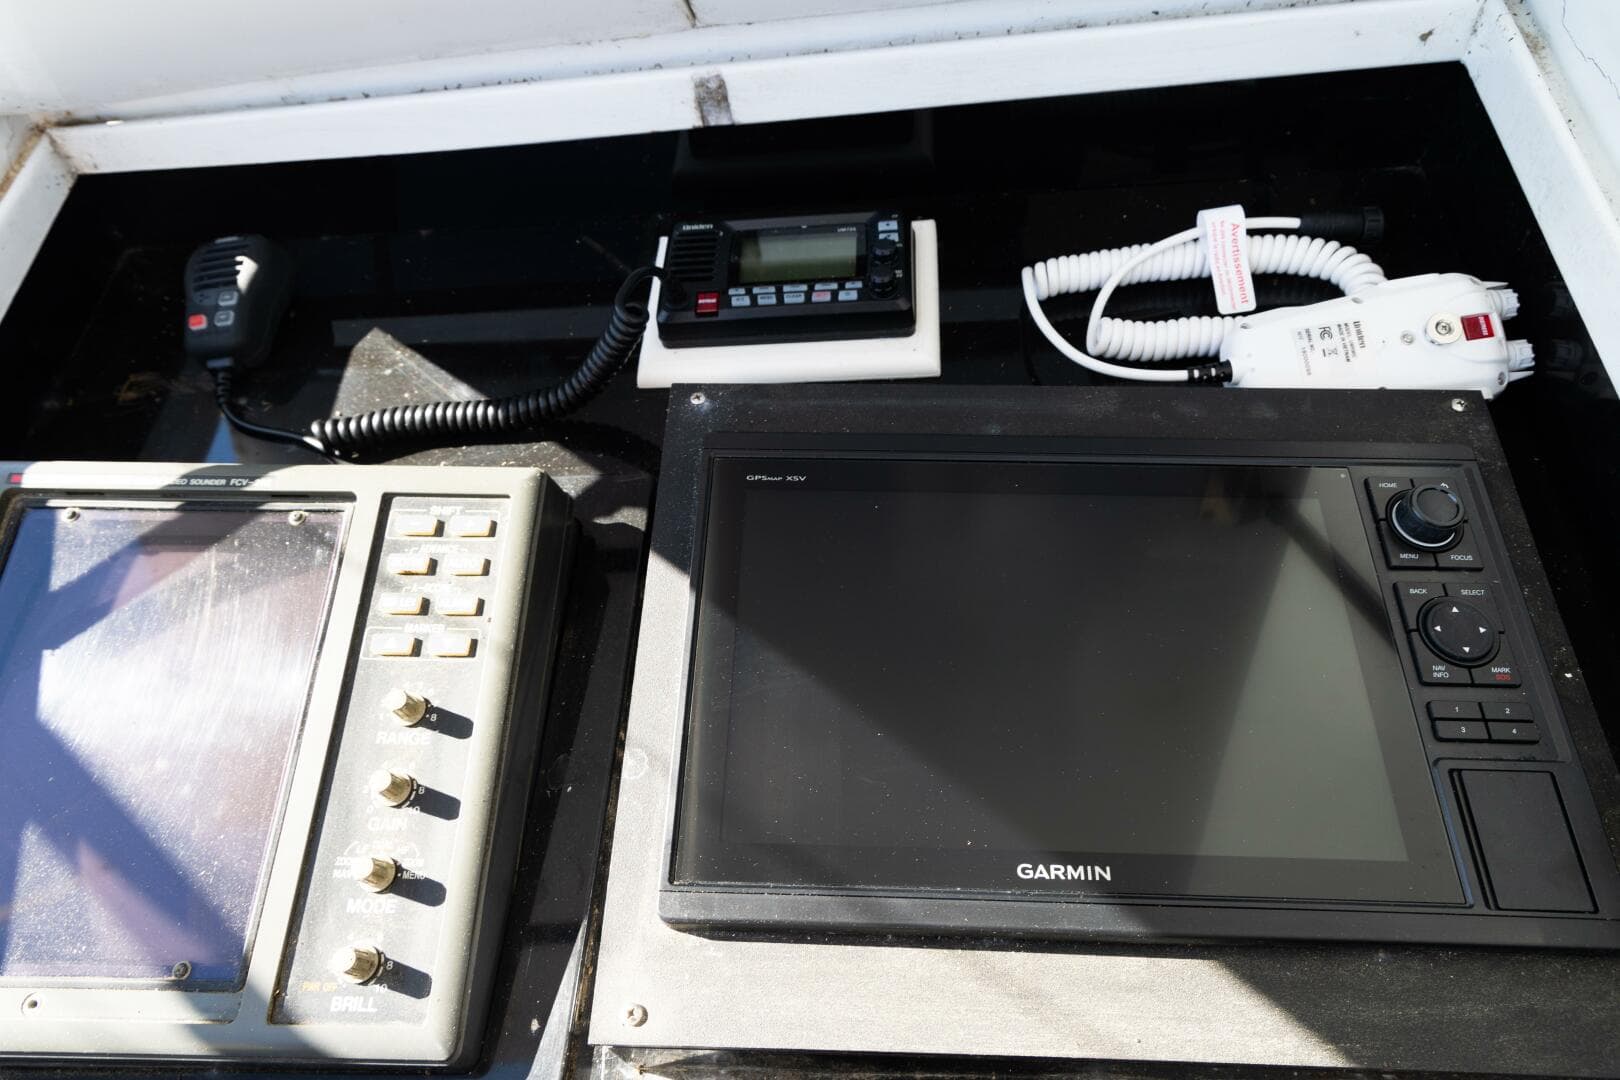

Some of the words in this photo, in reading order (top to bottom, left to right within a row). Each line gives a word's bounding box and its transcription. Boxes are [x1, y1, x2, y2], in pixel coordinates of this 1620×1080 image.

[1231, 223, 1249, 305] Avertissement
[189, 478, 226, 486] SOUNDER
[430, 714, 437, 722] 8
[376, 731, 432, 745] RANGE
[368, 816, 408, 832] GAIN
[402, 870, 426, 880] MENU
[1016, 864, 1112, 881] GARMIN
[346, 898, 398, 914] MODE
[386, 961, 394, 970] 8
[375, 984, 388, 993] 10
[330, 996, 378, 1012] BRILL
